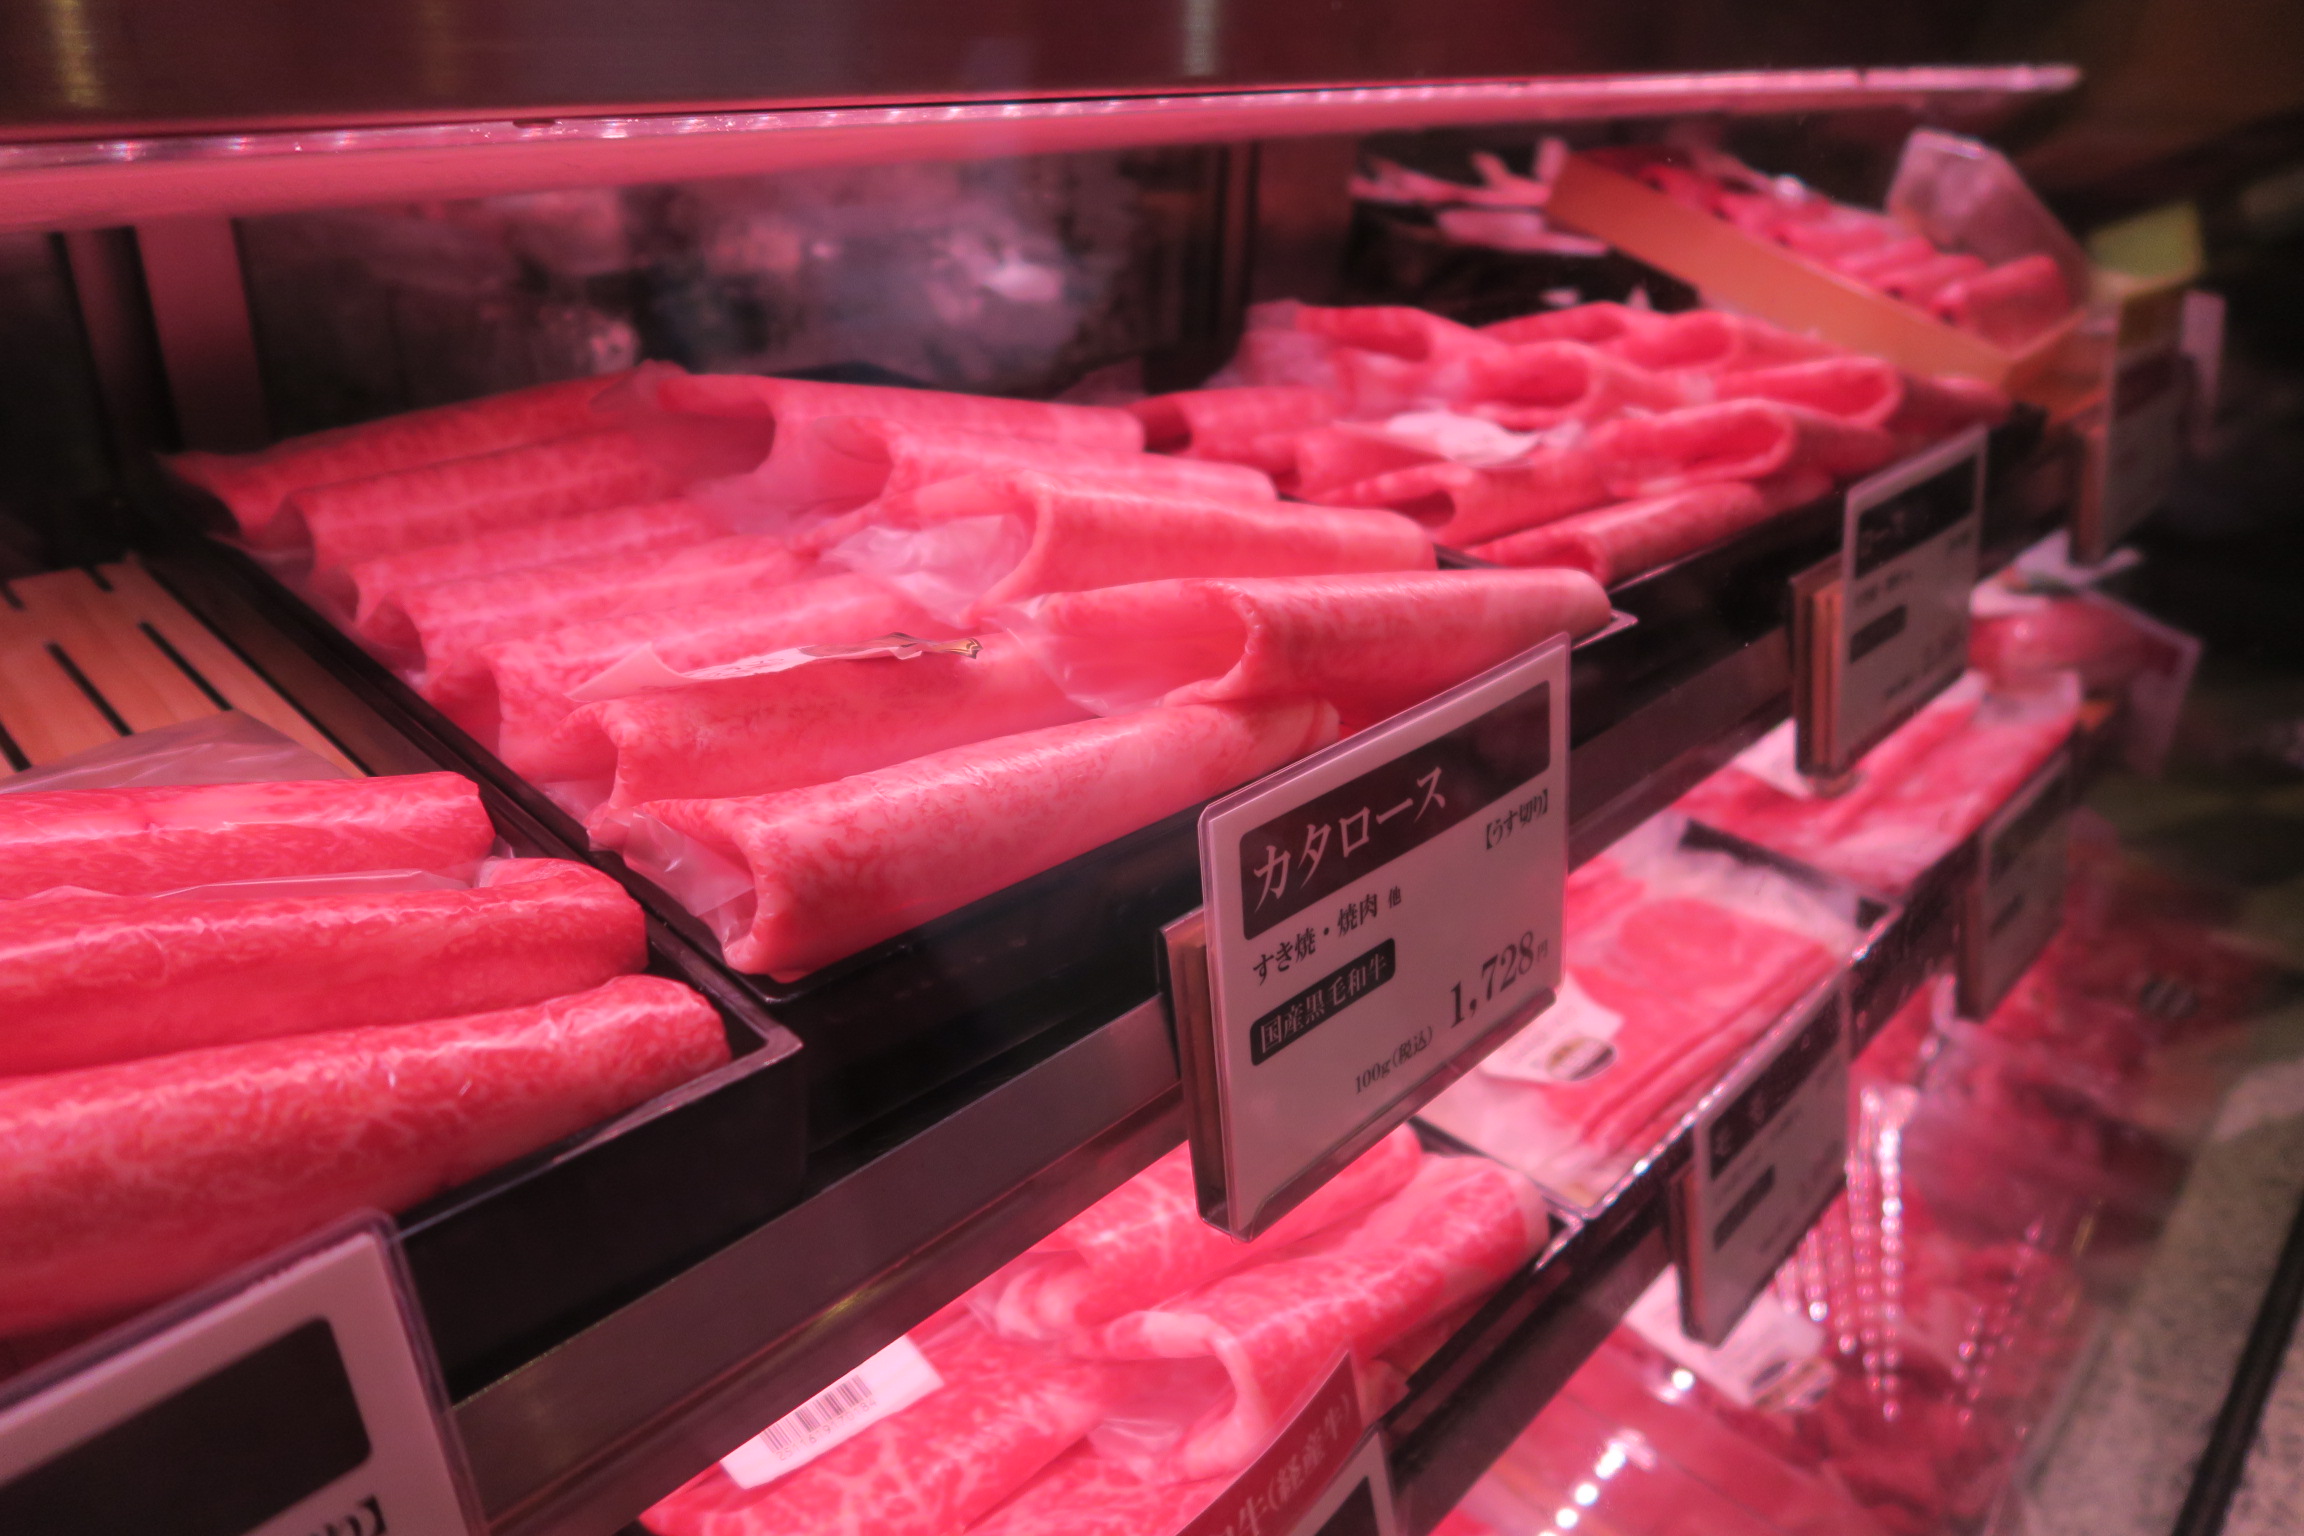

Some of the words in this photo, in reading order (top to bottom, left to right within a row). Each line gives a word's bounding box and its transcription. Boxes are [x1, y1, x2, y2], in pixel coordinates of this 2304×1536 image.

[1253, 766, 1446, 914] カタロース
[1259, 952, 1388, 1054] 国産黒毛和牛
